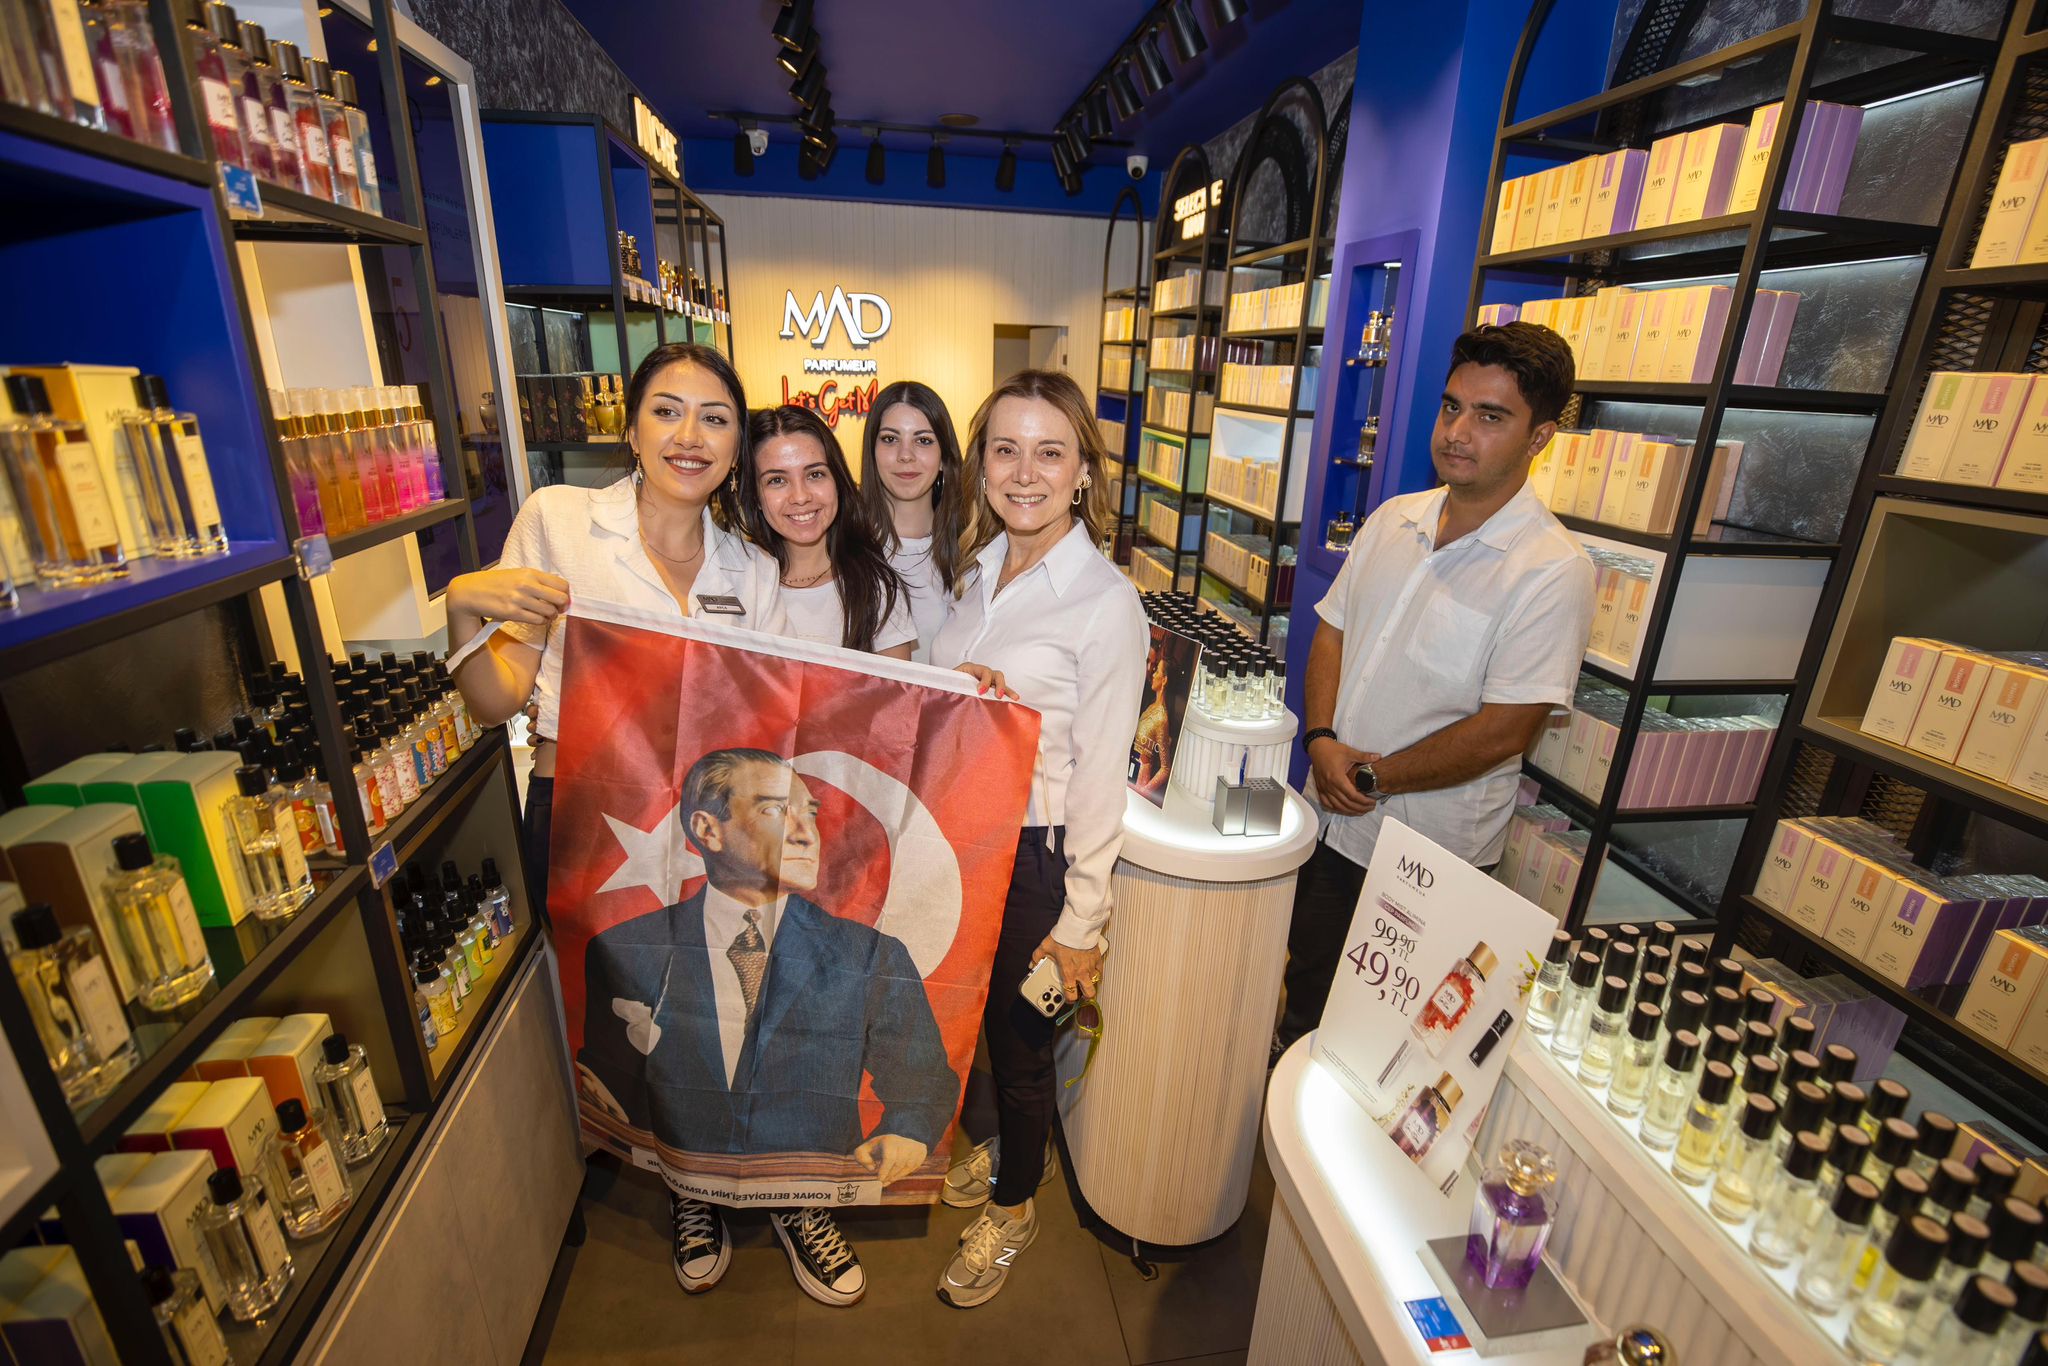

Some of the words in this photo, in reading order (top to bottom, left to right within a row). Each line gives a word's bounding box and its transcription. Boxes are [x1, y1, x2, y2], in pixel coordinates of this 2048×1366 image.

[779, 285, 892, 345] MAD
[803, 358, 877, 373] PARFUMEUR
[818, 380, 856, 428] Get
[1973, 418, 1999, 431] MAD
[1889, 679, 1912, 692] MAD
[1938, 695, 1962, 708] MAD
[1989, 710, 2016, 725] MAD
[1775, 856, 1792, 869] MAD
[1397, 854, 1434, 888] MAD
[1811, 875, 1830, 890] MAD
[1850, 897, 1870, 913] MAD
[1891, 921, 1914, 937] MAD
[1399, 947, 1409, 963] TL
[1347, 942, 1420, 1001] 49,90
[1392, 988, 1409, 1017] TL
[1990, 975, 2016, 993] MAD
